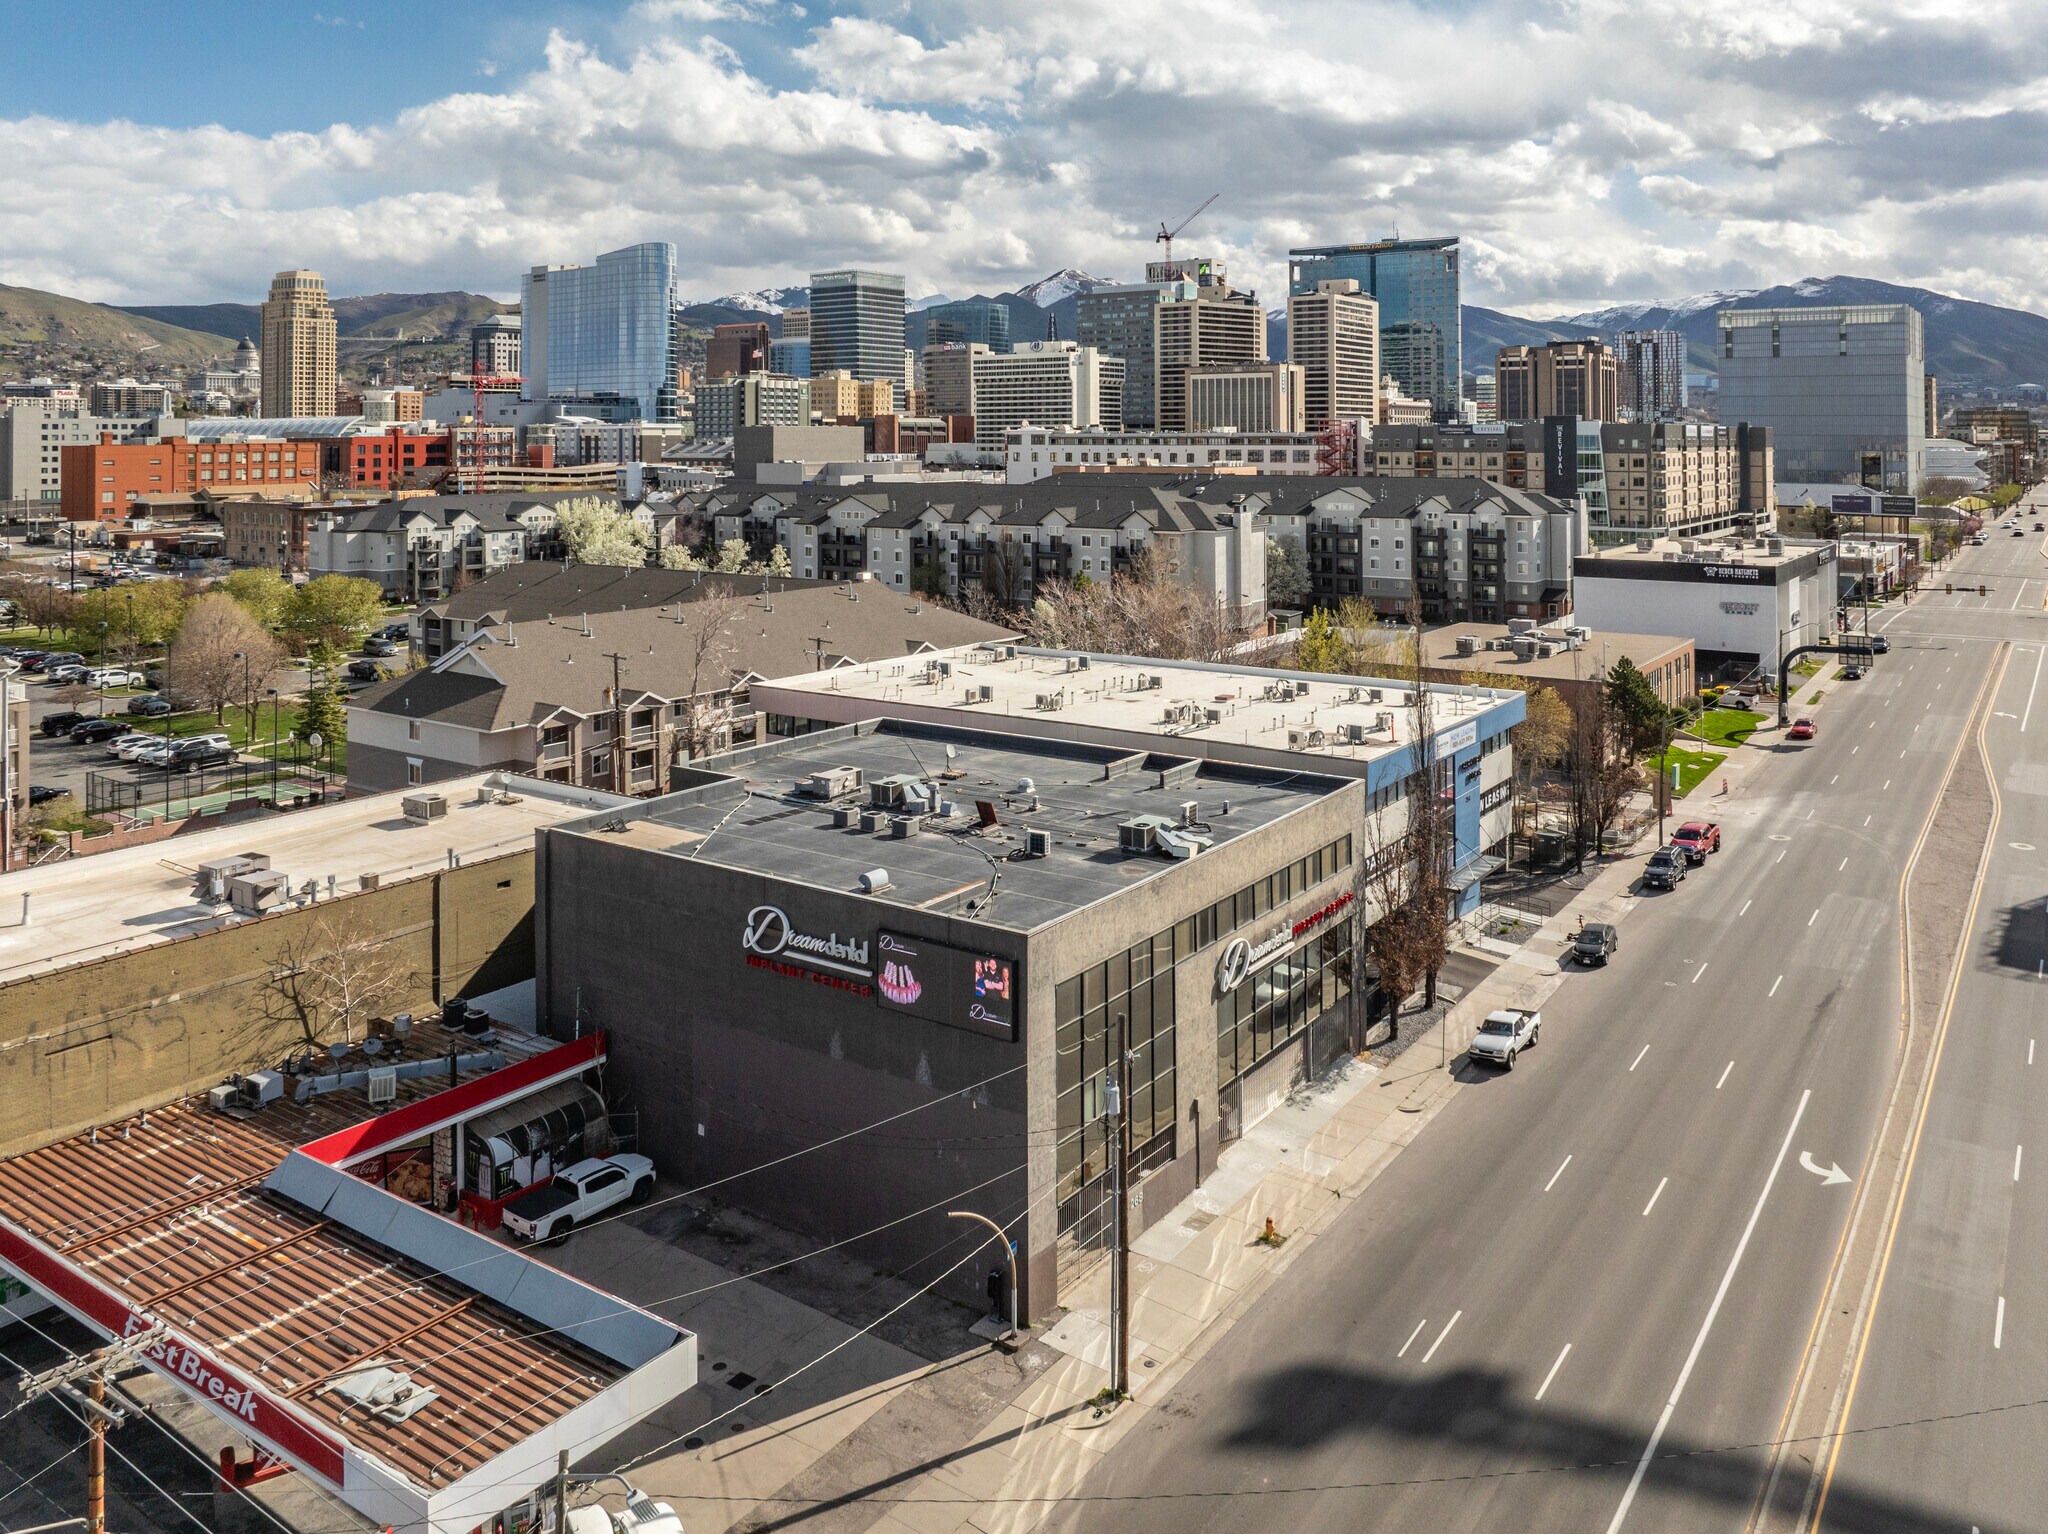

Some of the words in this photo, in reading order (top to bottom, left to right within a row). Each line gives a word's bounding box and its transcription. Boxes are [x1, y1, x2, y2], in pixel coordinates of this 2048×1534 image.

[1484, 784, 1510, 809] LEASING
[745, 955, 806, 979] IMPLANT
[811, 972, 872, 998] CENTER
